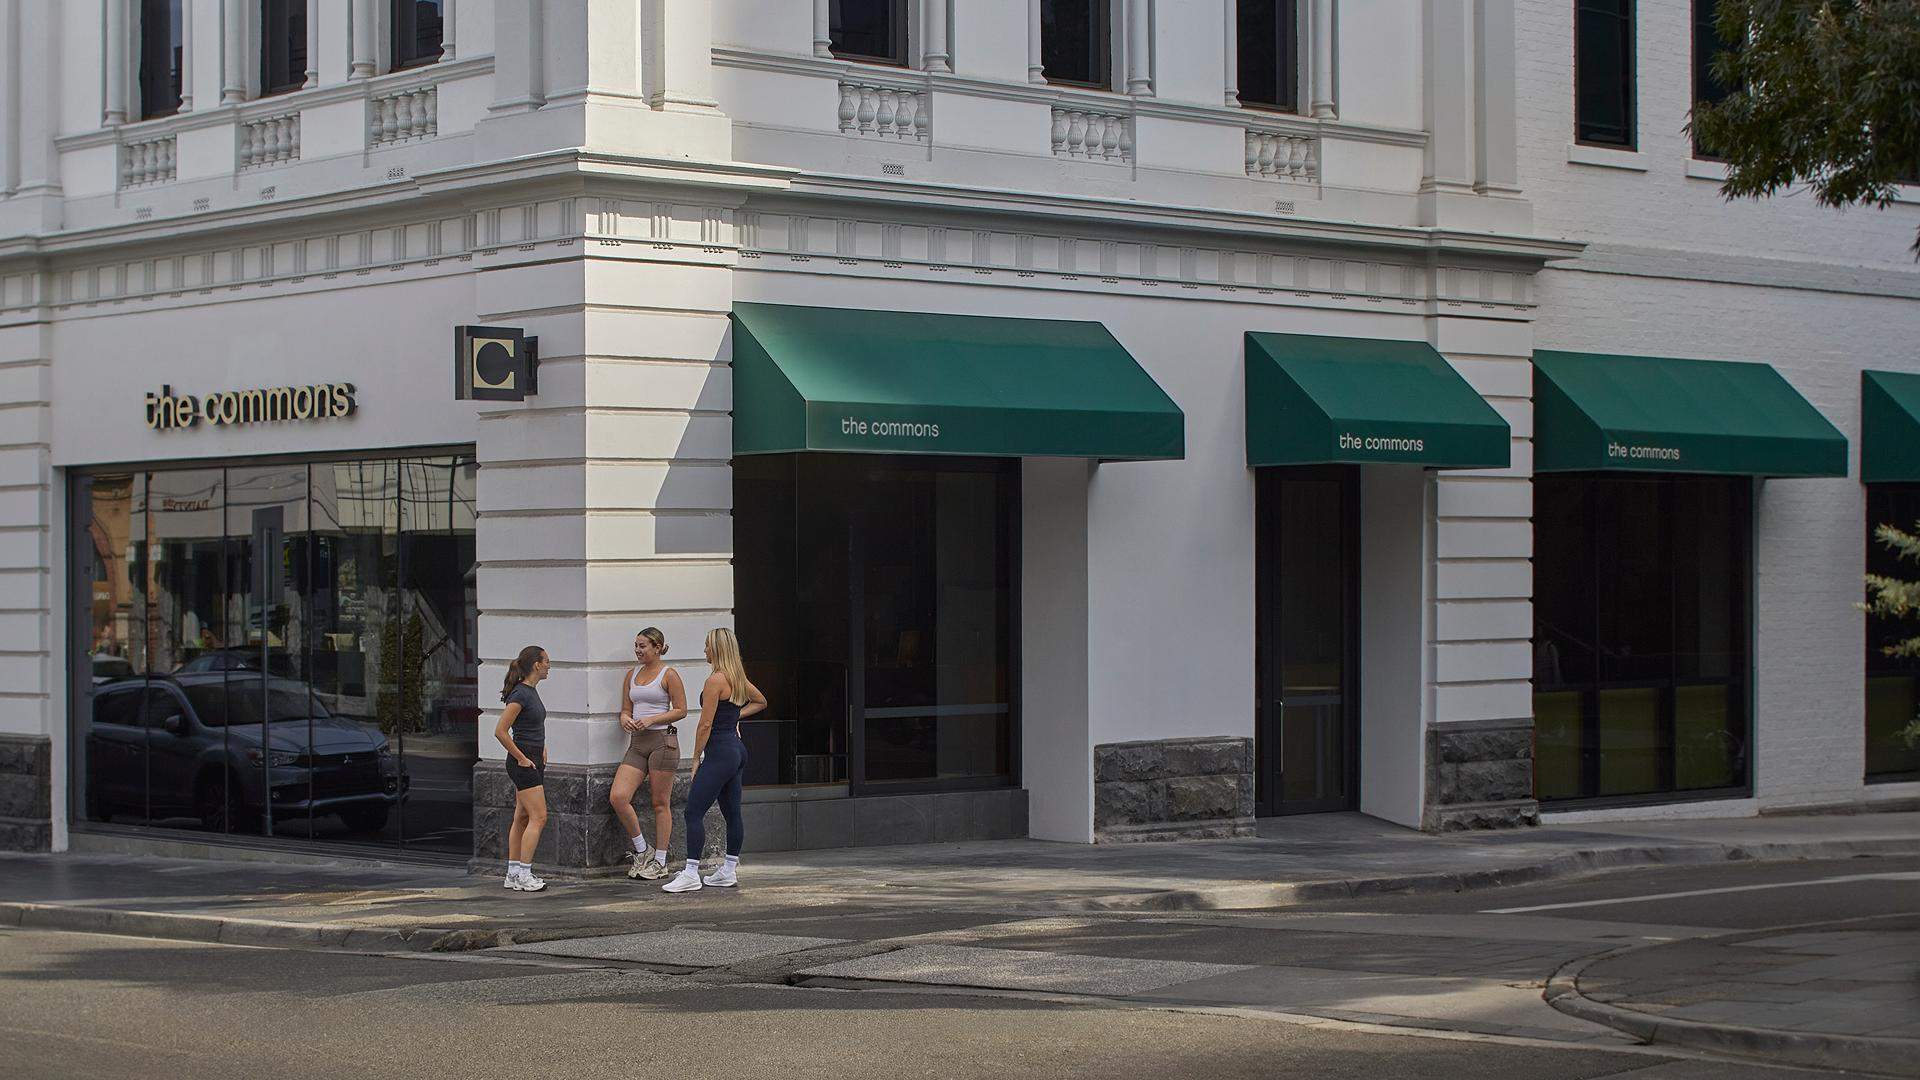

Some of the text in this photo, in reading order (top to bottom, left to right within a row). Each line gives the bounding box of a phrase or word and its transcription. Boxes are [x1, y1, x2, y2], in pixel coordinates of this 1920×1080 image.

[473, 338, 515, 389] C
[144, 383, 357, 429] the commons
[841, 416, 940, 437] the commons
[1339, 432, 1424, 452] the commons
[1608, 441, 1680, 460] the commons
